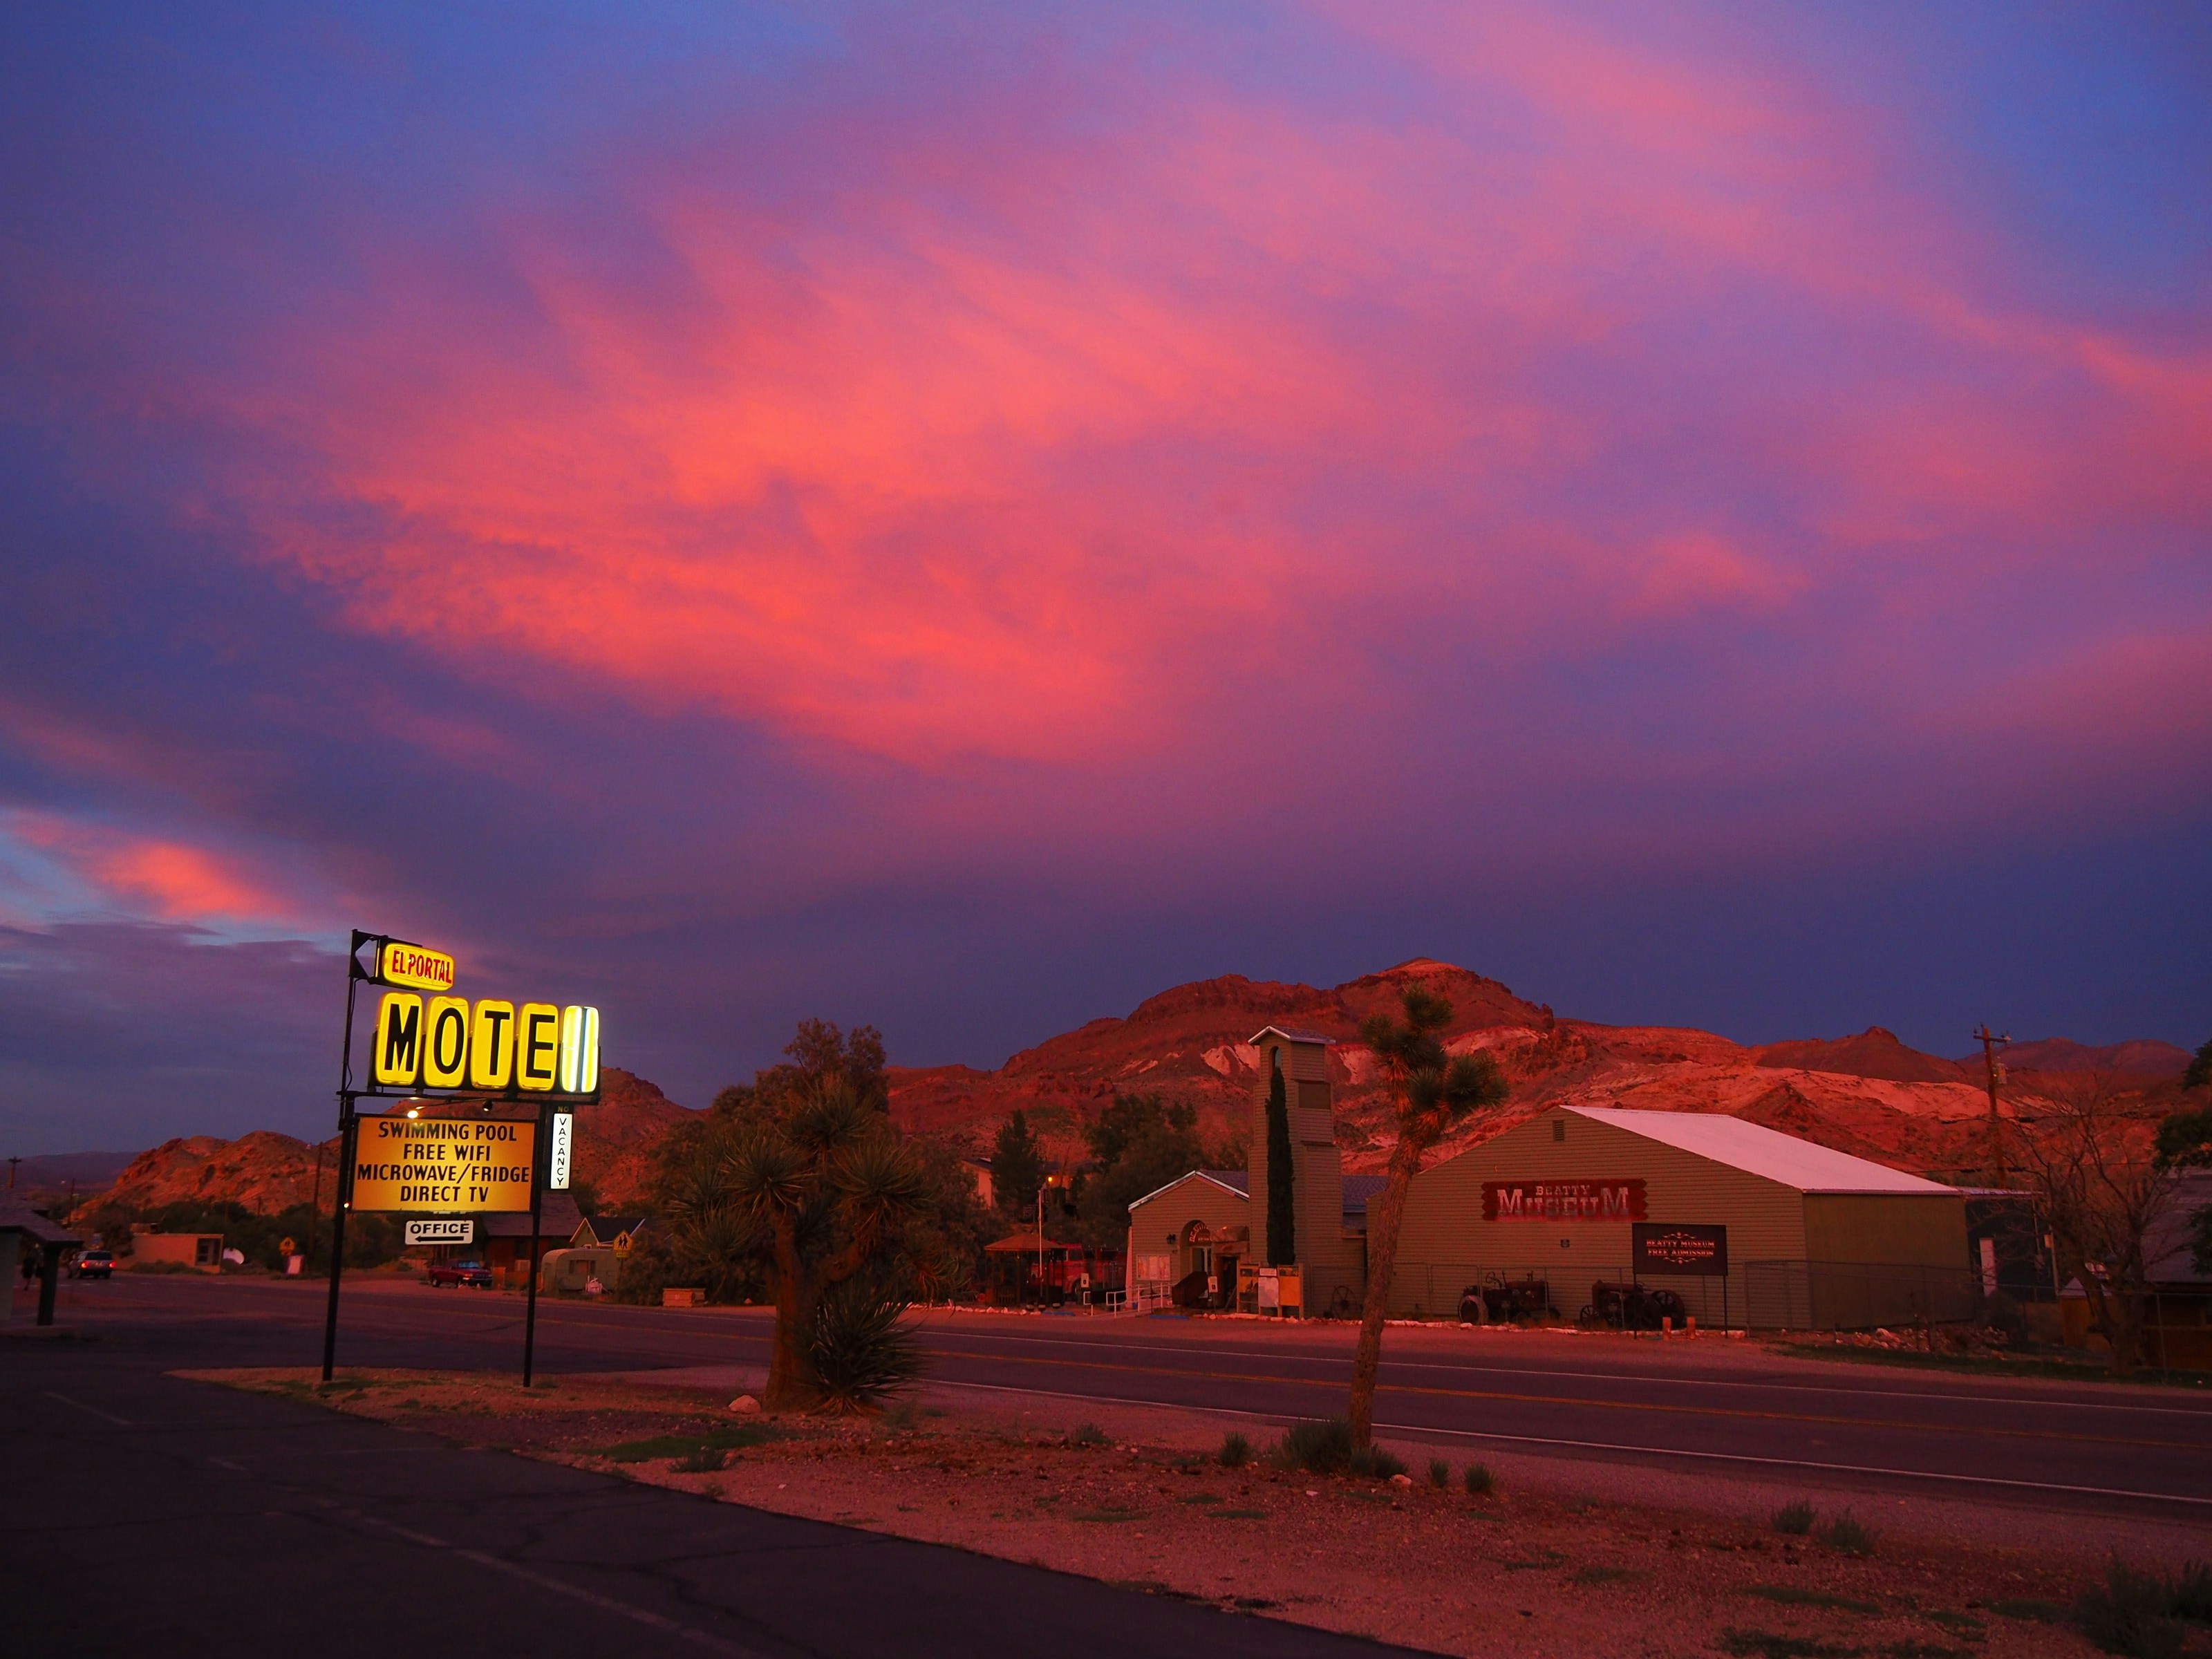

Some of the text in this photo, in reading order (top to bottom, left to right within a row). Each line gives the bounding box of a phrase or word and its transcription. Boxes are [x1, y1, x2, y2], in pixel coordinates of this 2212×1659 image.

[392, 950, 452, 984] EL PORTAL
[378, 1121, 517, 1142] SWIMMING POOL
[403, 1143, 491, 1162] FREE WIFI
[556, 1117, 567, 1186] VACANCY
[357, 1163, 529, 1184] MICROWAVE/FRIDGE
[400, 1185, 489, 1203] DIRECT TV
[1535, 1184, 1591, 1196] BEATTY
[1497, 1187, 1629, 1217] MUSEUM
[409, 1223, 470, 1235] OFFICE
[1647, 1248, 1714, 1257] FREE ADMISSION
[1680, 1240, 1715, 1248] MUSEUM
